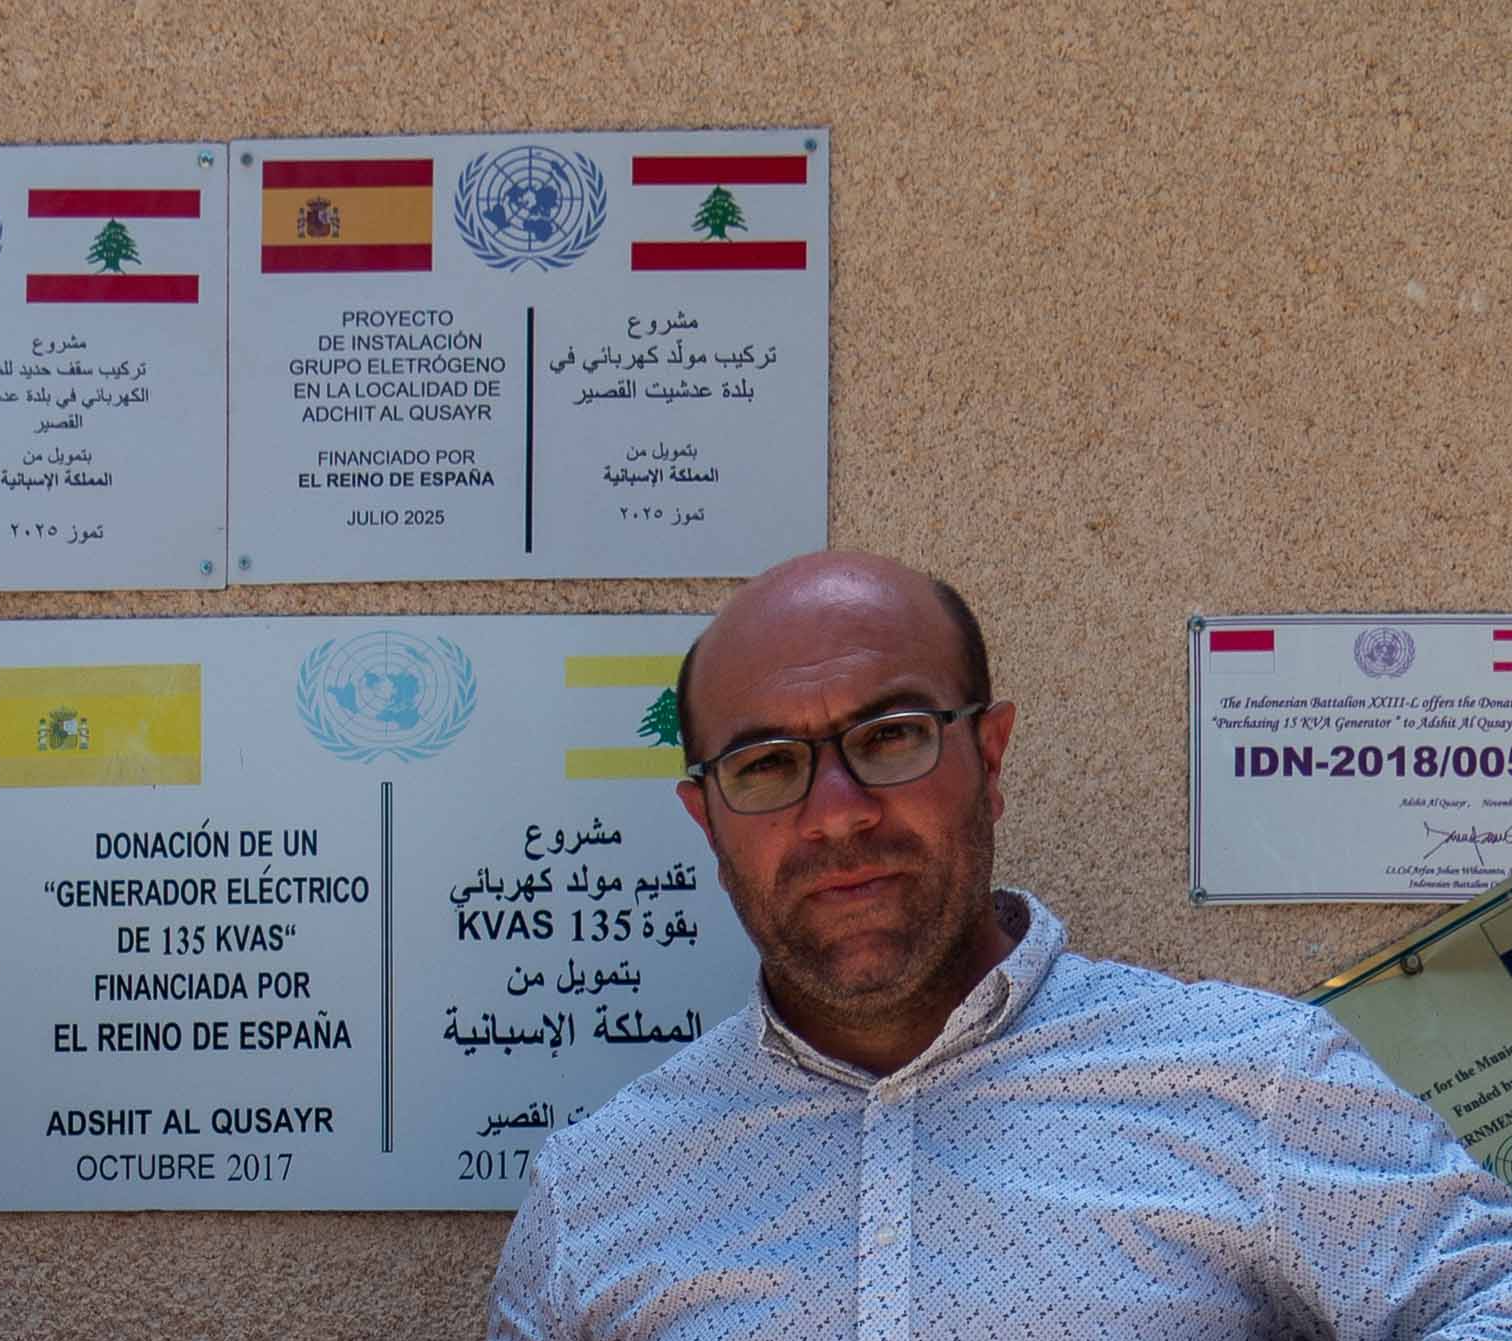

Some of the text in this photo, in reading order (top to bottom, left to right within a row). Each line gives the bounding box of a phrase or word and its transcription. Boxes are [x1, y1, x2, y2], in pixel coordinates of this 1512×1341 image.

[342, 310, 453, 327] PROYECTO
[628, 311, 698, 339] مشروع
[32, 335, 87, 357] مشروع
[319, 330, 482, 351] DE INSTALACIÓN
[289, 354, 506, 375] GRUPO ELETRÓGENO
[550, 345, 776, 374] تركيب كهربائي في
[19, 361, 146, 380] تركيب سقف حديد
[26, 387, 51, 406] بلدة
[56, 388, 76, 409] في
[294, 380, 500, 399] EN LA LOCALIDAD DE
[574, 378, 754, 405] بلدة عدشيت القصير
[34, 413, 83, 434] القصير
[302, 404, 491, 422] ADCHIT AL QUSAYR
[23, 447, 92, 466] بتمويل من
[318, 450, 475, 466] FINANCIADO POR
[626, 442, 697, 462] بتمويل من
[64, 470, 112, 486] المملكة
[299, 468, 494, 488] EL REINO DE ESPAÑA
[669, 465, 718, 482] المملكة
[347, 510, 445, 526] JULIO 2025
[672, 508, 704, 526] تموز
[68, 525, 103, 544] تموز
[1220, 696, 1241, 709] The
[1244, 696, 1307, 709] Indonesian
[1310, 696, 1366, 708] Battalion
[1367, 696, 1419, 709] XXIII-L
[1422, 696, 1455, 712] offers
[1458, 696, 1476, 708] the
[1284, 716, 1298, 728] 15
[1300, 716, 1331, 730] KVA
[1335, 717, 1392, 732] Generator
[1403, 718, 1416, 728] to
[1416, 716, 1456, 729] Adshit
[1458, 715, 1477, 730] Al
[96, 818, 317, 859] DONACIÓN DE UN
[525, 817, 621, 861] مشروع
[45, 864, 369, 907] “GENERADOR ELÉCTRICO
[450, 863, 696, 908] تقديم مولد كهربائي
[459, 909, 697, 947] بقوة 135 KVAS
[118, 927, 150, 953] DE
[163, 926, 205, 955] 135
[95, 972, 310, 1001] FINANCIADA POR
[507, 958, 640, 996] بتمويل من
[55, 1010, 351, 1052] EL REINO DE ESPAÑA
[443, 1005, 702, 1057] المملكة الإسبانية
[1434, 1081, 1453, 1094] for
[1454, 1069, 1476, 1083] the
[1452, 1086, 1501, 1117] Funded
[47, 1108, 333, 1136] ADSHIT AL QUSAYR
[477, 1102, 554, 1137] القصير
[77, 1153, 292, 1181] OCTUBRE 2017
[459, 1150, 531, 1180] 2017
